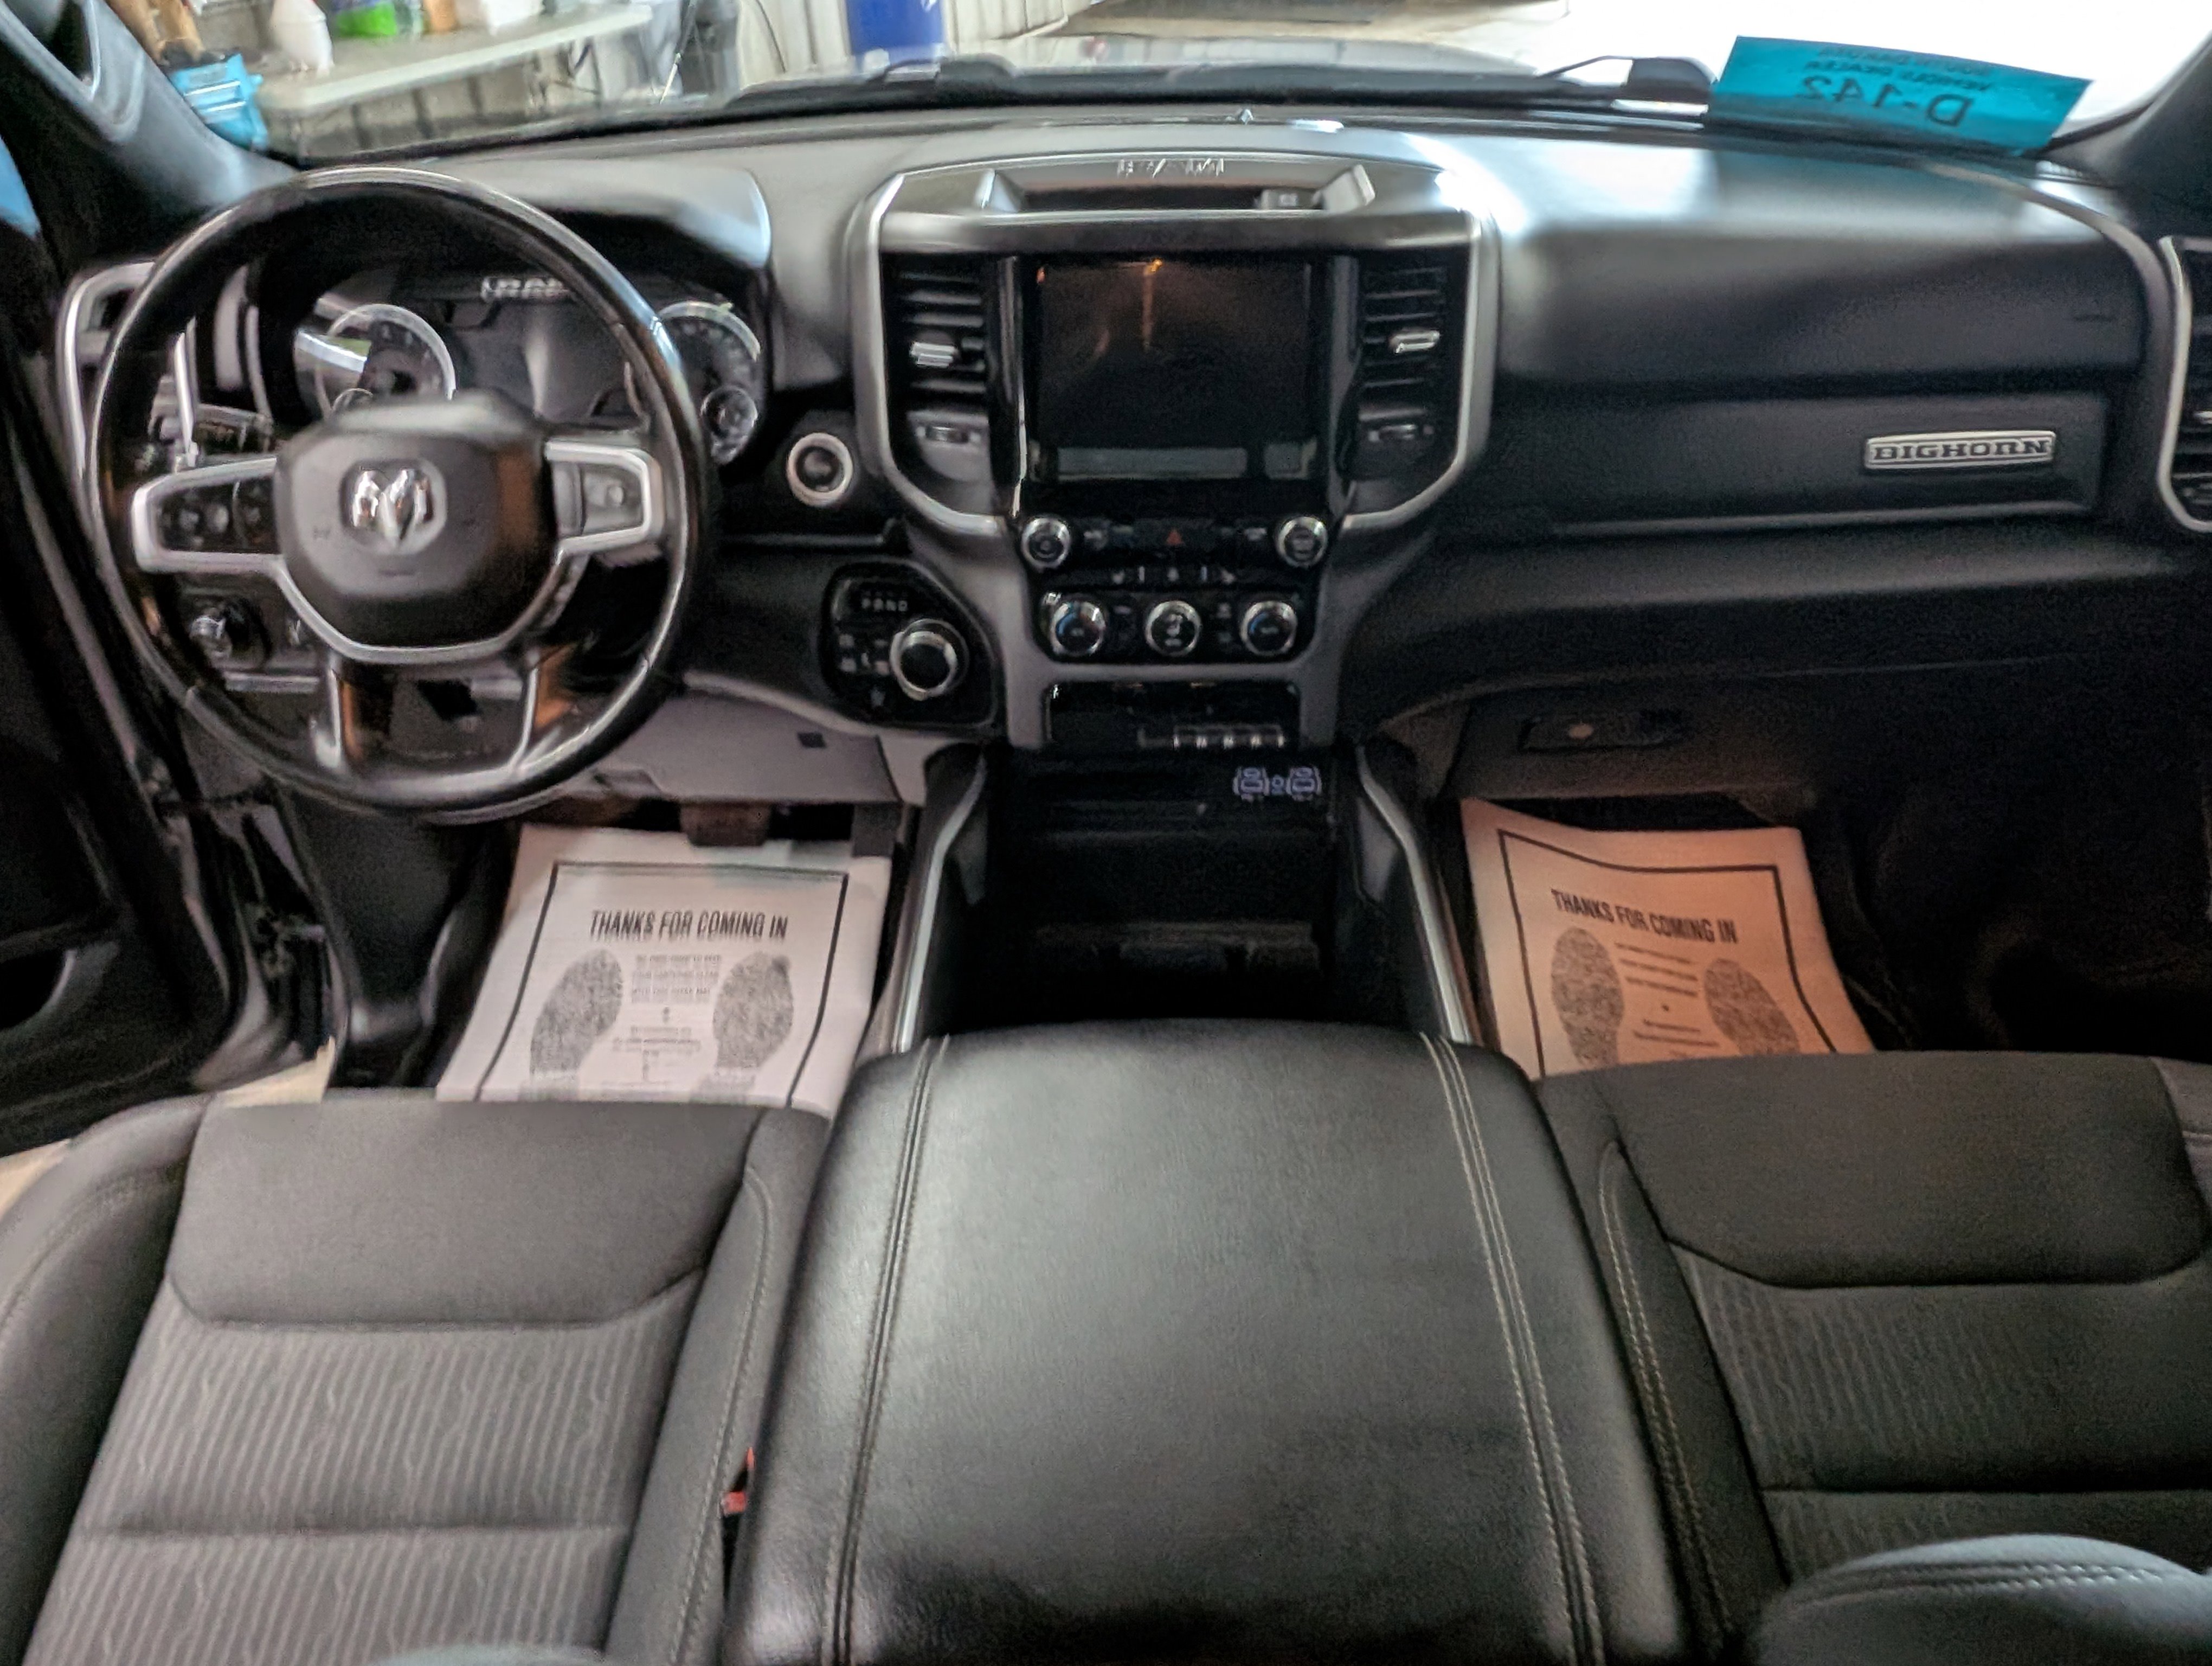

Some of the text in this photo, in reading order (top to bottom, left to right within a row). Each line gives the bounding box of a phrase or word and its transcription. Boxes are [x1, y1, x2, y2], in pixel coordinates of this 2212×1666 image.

[1873, 439, 2050, 460] BIGHORN
[590, 910, 788, 941] THANKS FOR COMING IN
[1550, 888, 1738, 944] THANKS FOR COMING IN
